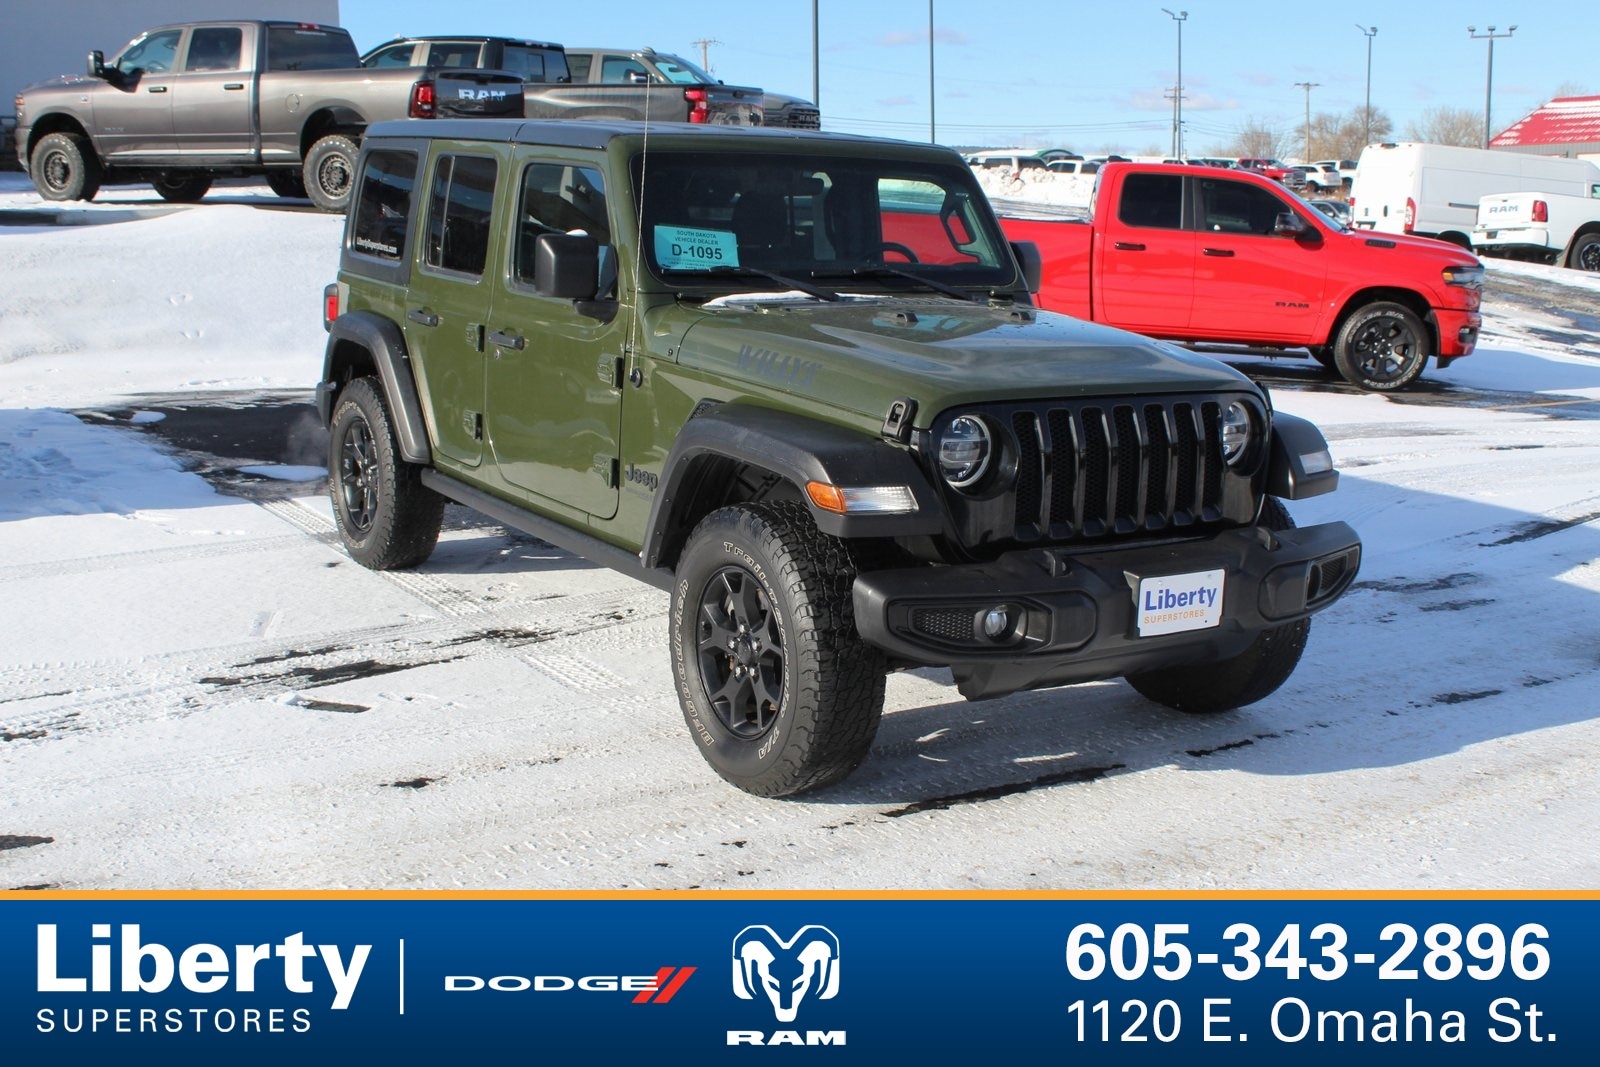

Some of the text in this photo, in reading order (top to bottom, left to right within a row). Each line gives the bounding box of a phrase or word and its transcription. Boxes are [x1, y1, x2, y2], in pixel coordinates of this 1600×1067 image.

[458, 88, 506, 101] RAM
[1489, 205, 1519, 214] RAM
[697, 238, 719, 246] DEALER
[671, 243, 723, 260] D-1095
[1275, 301, 1310, 309] RAM
[737, 343, 823, 387] WILLYS
[625, 463, 658, 492] Jeep
[1144, 586, 1217, 611] Liberty
[1143, 609, 1205, 624] SUPERSTORES
